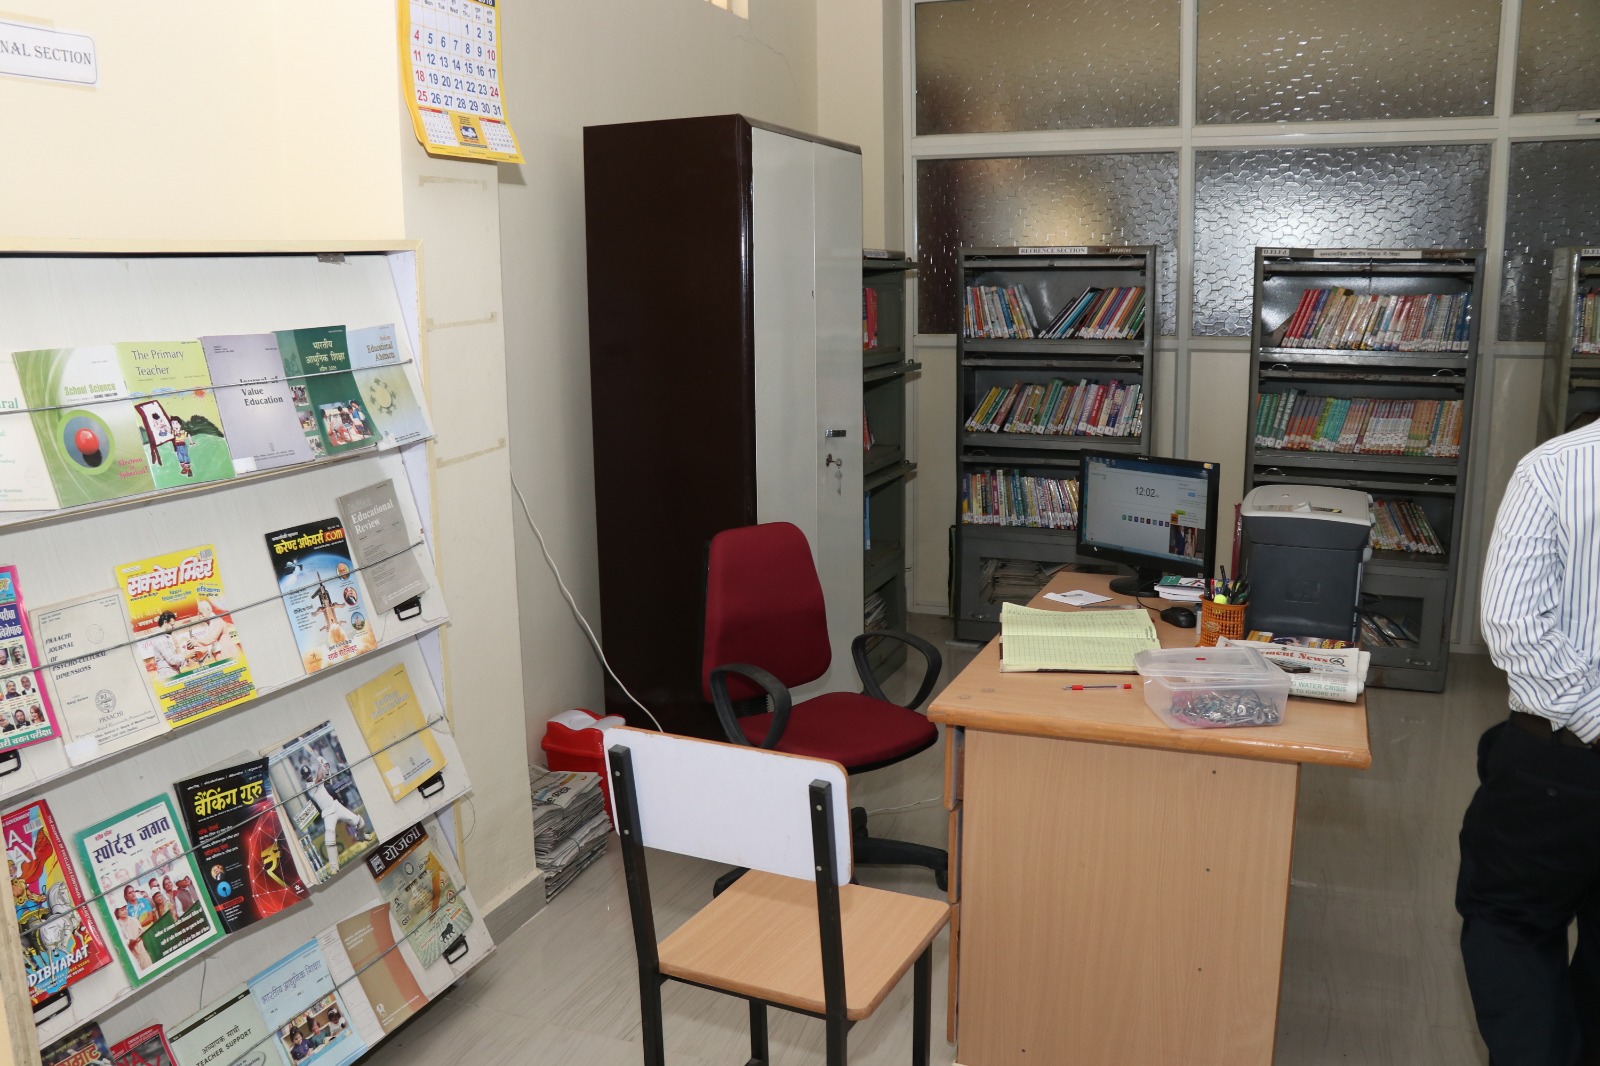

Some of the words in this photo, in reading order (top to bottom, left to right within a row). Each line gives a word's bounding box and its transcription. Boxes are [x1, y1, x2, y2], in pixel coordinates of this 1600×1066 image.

[466, 24, 469, 34] 1
[477, 28, 481, 38] 2
[488, 31, 492, 41] 3
[414, 30, 419, 41] 4
[428, 33, 433, 44] 5
[441, 36, 446, 48] 6
[454, 40, 458, 50] 7
[465, 43, 470, 54] 8
[477, 46, 482, 57] 9
[487, 50, 495, 60] 10
[34, 46, 91, 65] SECTION
[414, 50, 422, 62] 11
[427, 53, 436, 65] 12
[440, 56, 448, 68] 13
[452, 60, 461, 71] 14
[465, 62, 473, 74] 15
[476, 65, 484, 76] 16
[488, 68, 496, 79] 17
[416, 69, 425, 82] 18
[429, 73, 438, 85] 19
[442, 76, 451, 87] 20
[454, 78, 463, 90] 21
[466, 81, 475, 93] 22
[478, 84, 487, 95] 23
[490, 86, 499, 97] 24
[417, 90, 427, 102] 25
[431, 93, 441, 104] 26
[444, 96, 453, 106] 27
[456, 98, 466, 109] 28
[468, 100, 478, 111] 29
[481, 102, 490, 114] 30
[492, 105, 502, 116] 31
[312, 339, 333, 349] भारतीय
[367, 342, 393, 354] Educational
[132, 350, 149, 360] The
[151, 350, 184, 361] Primary
[305, 353, 329, 366] आधुनिक
[330, 352, 345, 362] शिक्षा
[375, 352, 395, 362] Abstracts
[135, 365, 170, 376] Teacher
[64, 384, 87, 396] School
[88, 382, 116, 394] Science
[241, 387, 264, 396] Value
[244, 396, 284, 406] Education
[1136, 486, 1155, 498] 12:02
[351, 499, 394, 524] Educational
[354, 520, 381, 534] Review
[325, 529, 343, 542] .com
[45, 633, 72, 644] PRAACHI
[48, 642, 75, 653] JOURNAL
[1298, 652, 1328, 663] News
[56, 665, 92, 681] DIMENSIONS
[99, 711, 124, 724] PRAACHI
[194, 787, 237, 816] बैंकिंग
[240, 780, 263, 805] गुरु
[137, 816, 170, 841] जगत
[383, 826, 422, 861] योजना
[28, 944, 88, 987] DIBHARAT
[260, 985, 283, 1005] भारतीय
[283, 972, 306, 991] आधुनिक
[305, 960, 322, 974] शिक्षा
[195, 1047, 224, 1066] TEACHER
[225, 1028, 252, 1050] SUPPORT
[202, 1035, 225, 1054] अध्यापक
